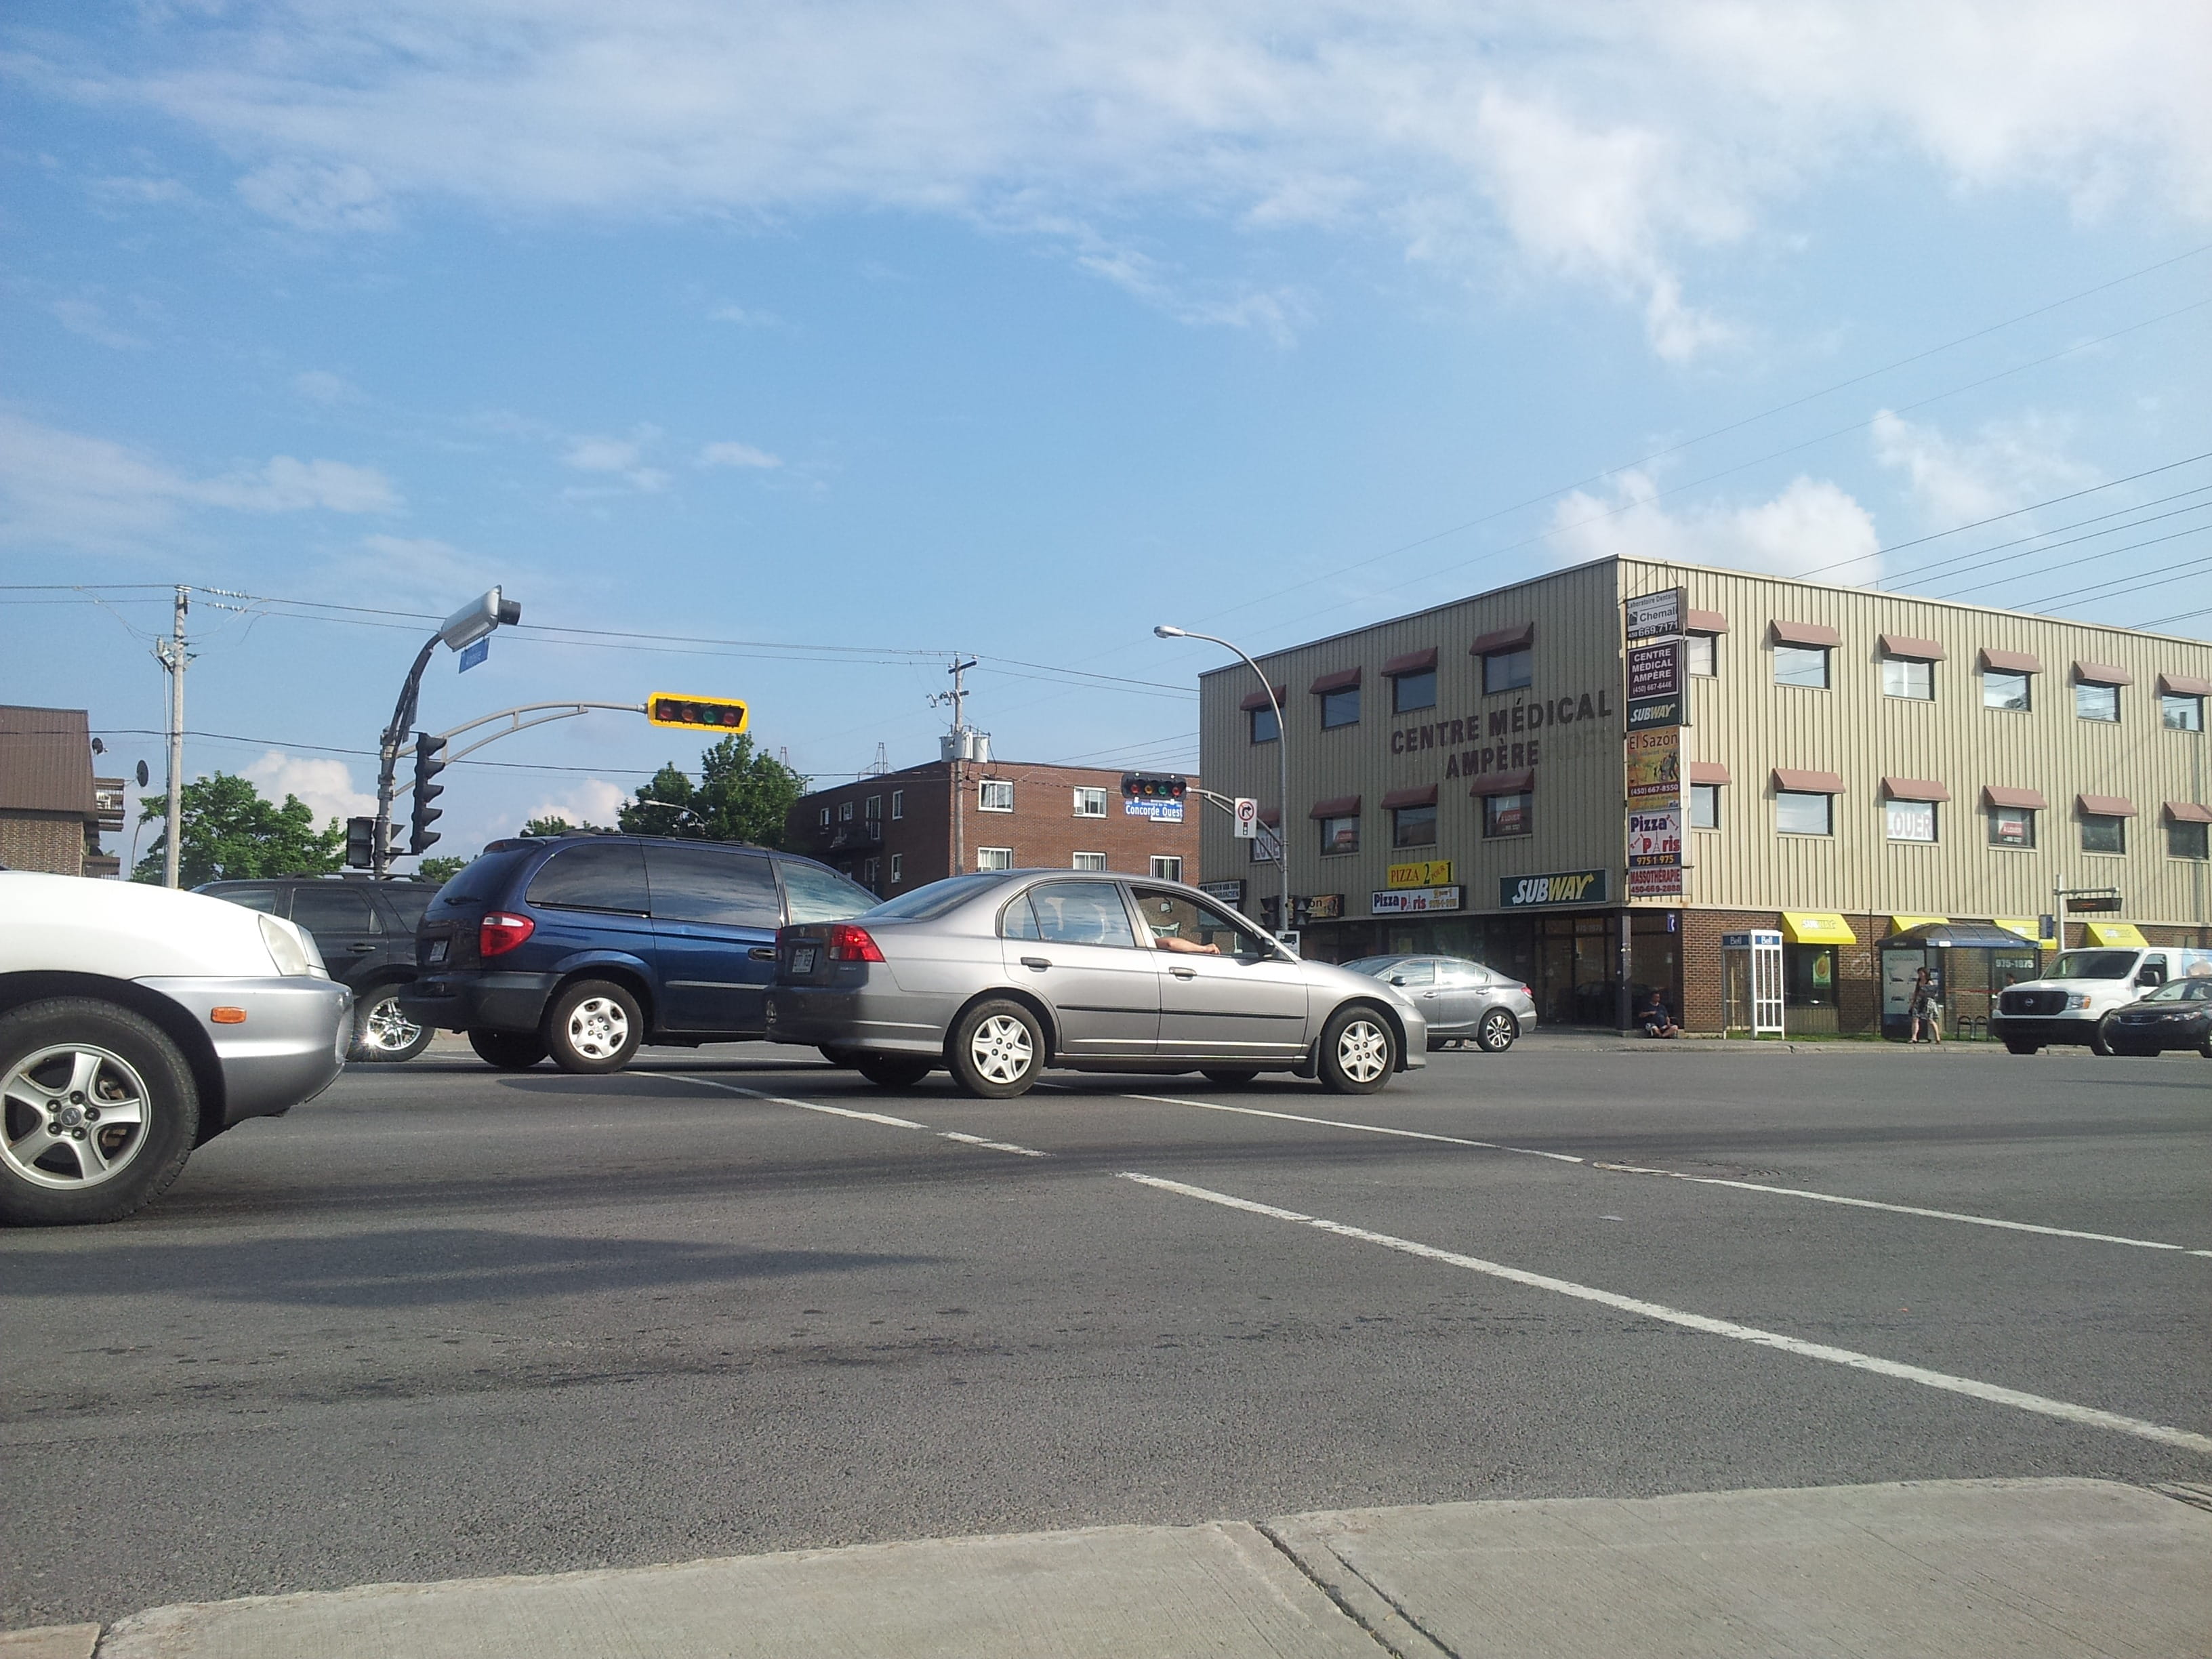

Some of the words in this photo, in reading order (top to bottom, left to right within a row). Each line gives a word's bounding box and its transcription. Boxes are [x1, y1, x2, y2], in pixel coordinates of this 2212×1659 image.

[1639, 621, 1678, 636] 669.7171
[1634, 648, 1671, 662] CENTRE
[1632, 659, 1673, 673] MÉDICAL
[1633, 669, 1672, 683] AMPÈRE
[1630, 703, 1676, 723] SUBWAY
[1391, 716, 1479, 754] CENTRE
[1488, 690, 1612, 737] MÉDICAL
[1629, 735, 1639, 749] El
[1642, 731, 1677, 748] Sazón
[1446, 737, 1539, 779] AMPÈRE
[1631, 787, 1647, 796] (450)
[1647, 784, 1679, 794] 667-8550
[1126, 804, 1160, 816] Concorde
[1162, 806, 1183, 817] Ouest
[1631, 815, 1667, 833] Pizza
[1886, 812, 1931, 838] LOUER
[1391, 868, 1419, 882] PIZZA
[1424, 863, 1431, 884] 2
[1446, 861, 1452, 882] 1
[1512, 873, 1594, 905] SUBWAY
[1374, 893, 1399, 907] Pizza
[1730, 936, 1742, 945] Bell
[1761, 936, 1773, 945] Bell
